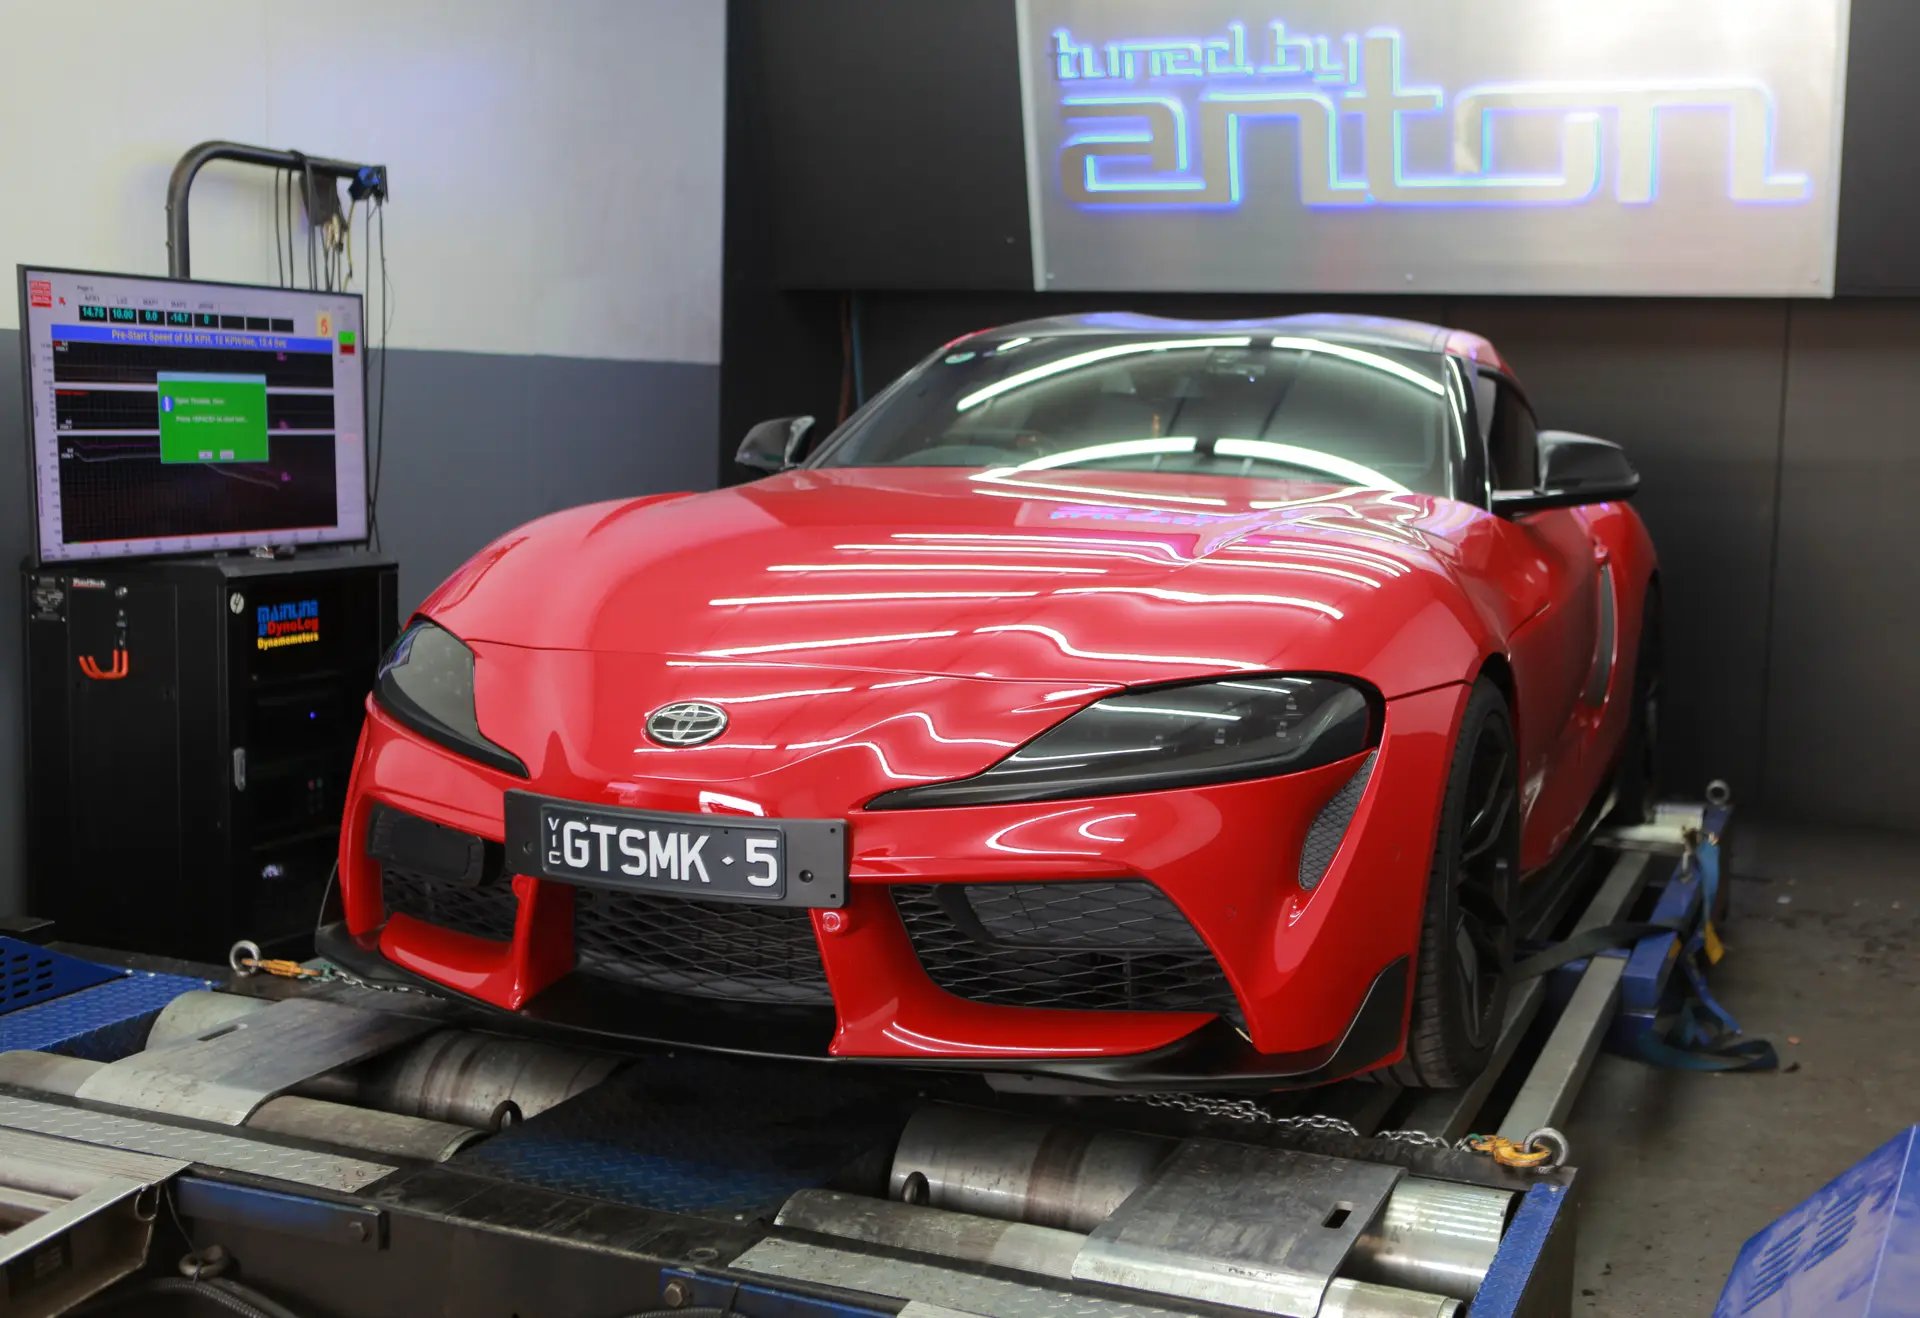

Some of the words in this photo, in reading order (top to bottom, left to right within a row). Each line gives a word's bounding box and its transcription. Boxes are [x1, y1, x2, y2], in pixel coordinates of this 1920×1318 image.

[1053, 23, 1255, 80] tuned
[1259, 21, 1358, 87] by
[1058, 28, 1812, 210] anton
[145, 310, 158, 321] 0.0
[547, 816, 561, 865] VIC
[563, 820, 711, 883] GTSMK
[745, 837, 778, 888] 5
